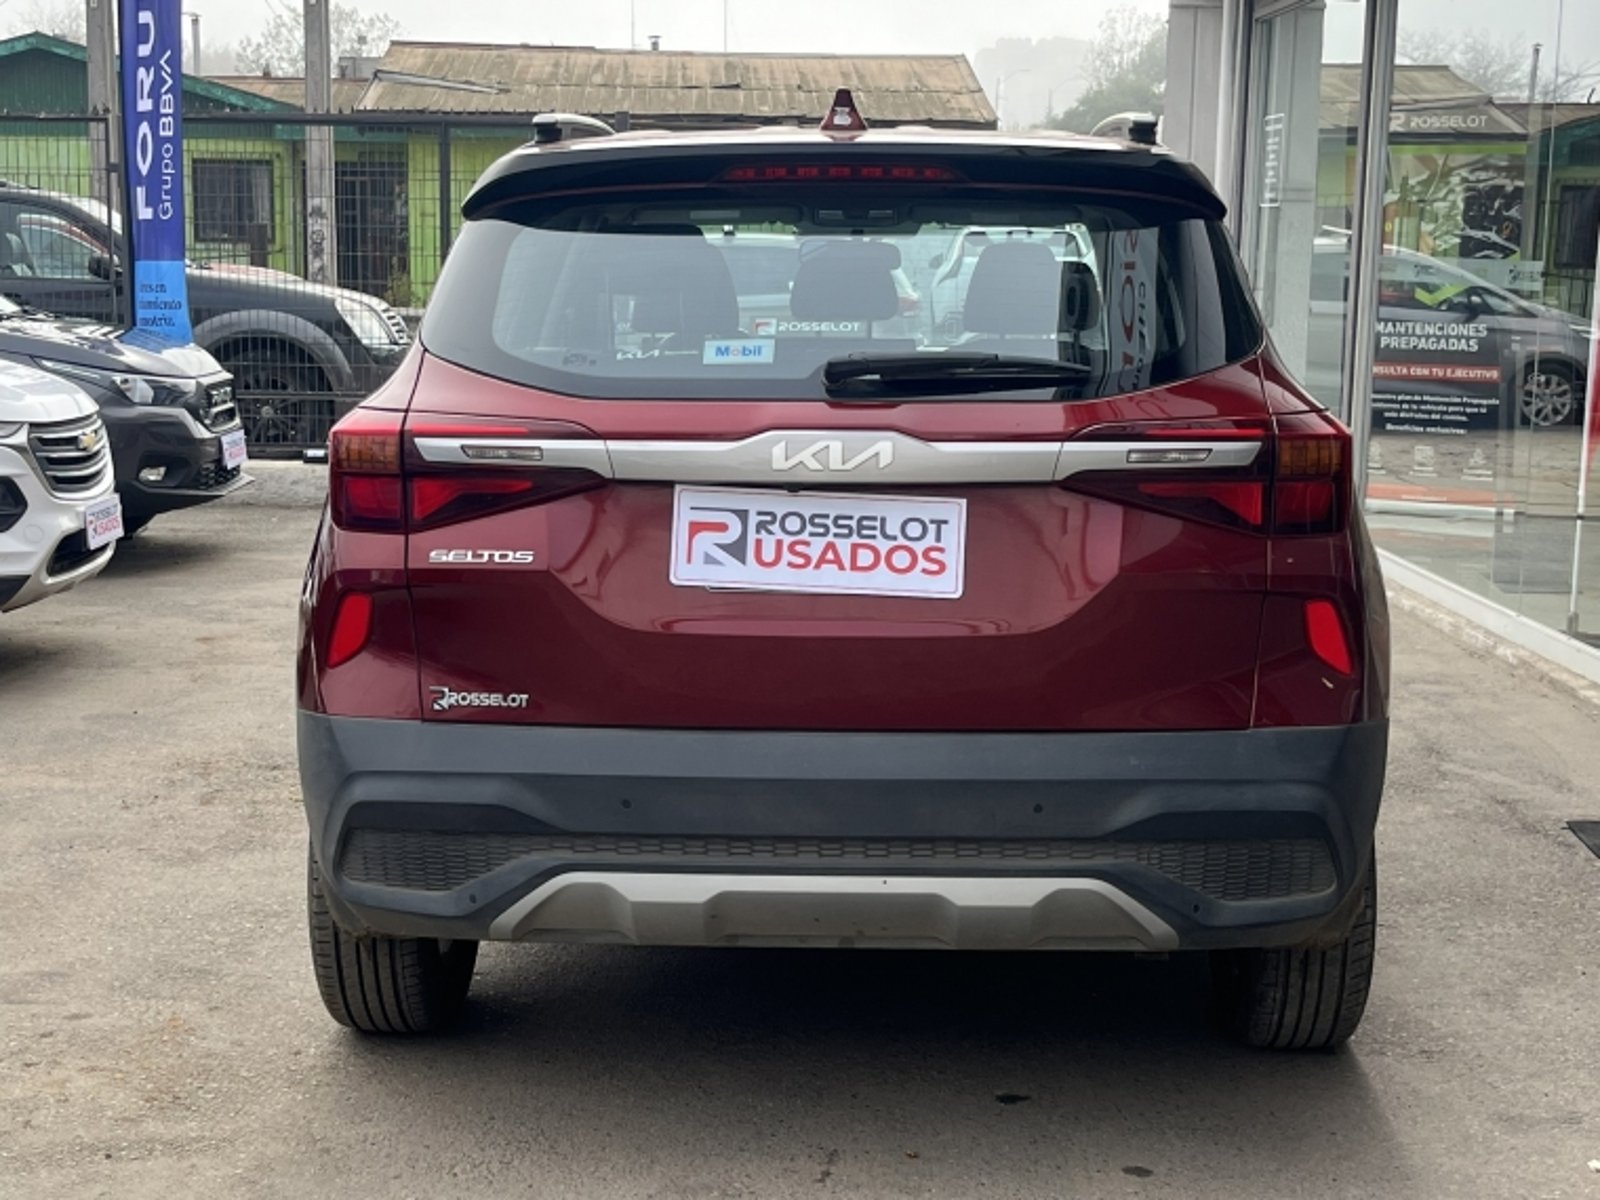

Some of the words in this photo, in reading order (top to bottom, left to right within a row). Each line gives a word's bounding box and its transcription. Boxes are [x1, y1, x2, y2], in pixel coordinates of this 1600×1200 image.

[159, 49, 174, 137] BBVA
[1409, 114, 1488, 129] ROSSELOT
[159, 143, 176, 220] Grupo
[778, 321, 861, 332] ROSSELOT
[715, 345, 763, 358] Mobil
[1380, 336, 1479, 353] PREPAGADAS
[1431, 367, 1445, 377] TU
[1446, 367, 1499, 380] EJECUTIVO
[771, 440, 894, 472] KIA
[755, 511, 949, 543] ROSSELOT
[428, 549, 535, 563] SELTOS
[753, 539, 946, 576] USADOS
[449, 692, 529, 708] ROSSELOT
